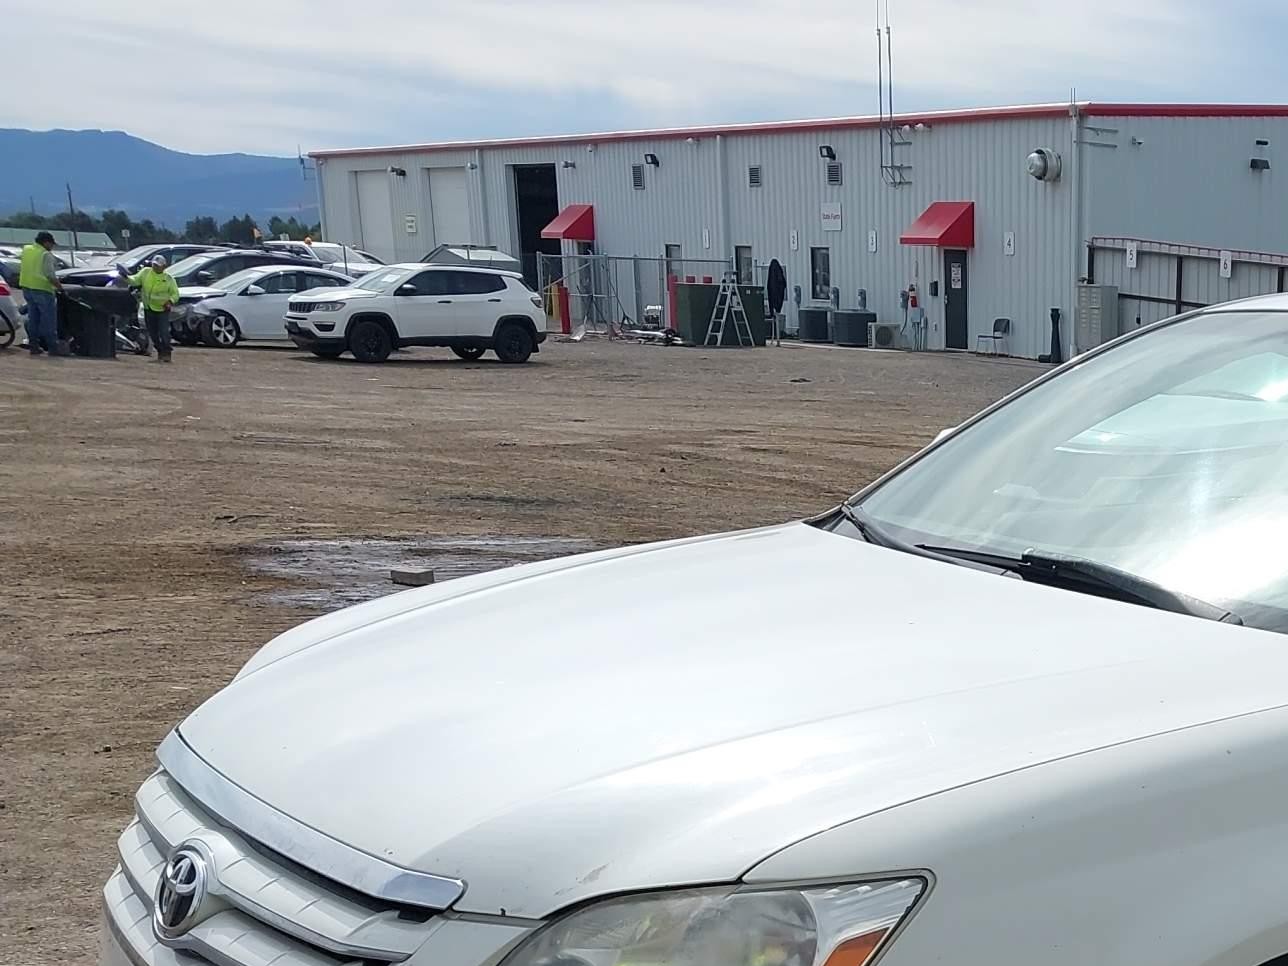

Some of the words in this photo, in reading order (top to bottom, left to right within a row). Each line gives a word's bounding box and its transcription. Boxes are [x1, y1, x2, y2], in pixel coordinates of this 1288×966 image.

[1006, 237, 1012, 248] 4
[1128, 249, 1134, 261] 5
[1223, 259, 1229, 270] 6
